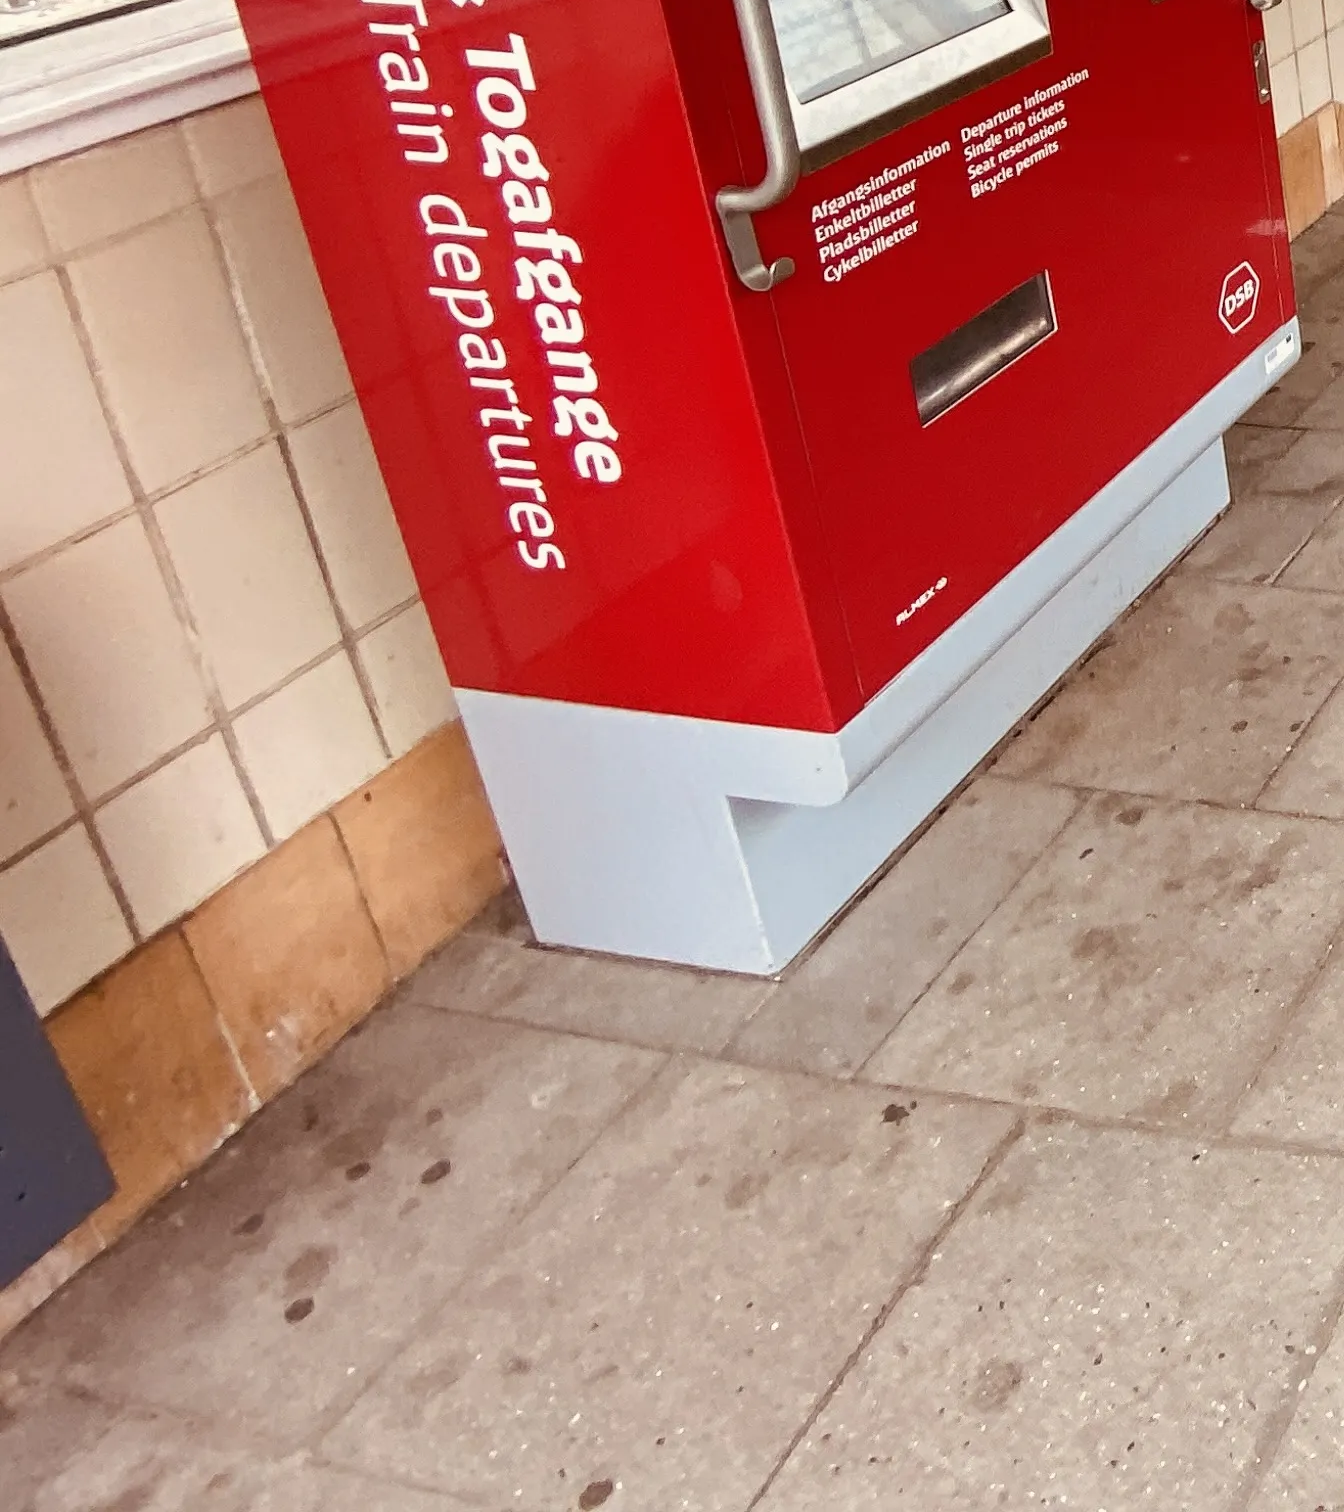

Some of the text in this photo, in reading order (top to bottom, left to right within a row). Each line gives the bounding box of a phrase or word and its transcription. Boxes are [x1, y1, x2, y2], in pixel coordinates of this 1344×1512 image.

[960, 69, 1089, 143] Departure information
[963, 99, 1065, 162] Single trip tickets
[967, 117, 1068, 180] Seat reservations
[971, 141, 1059, 198] Bicycle permits
[812, 140, 951, 222] Afgangsinformation
[815, 179, 916, 242] Enkeltbilletter
[465, 32, 622, 485] Togafgange
[819, 201, 916, 263] Pladsbilletter
[823, 220, 918, 282] Cykelbilletter
[1224, 279, 1254, 317] DSB
[419, 192, 566, 571] departures
